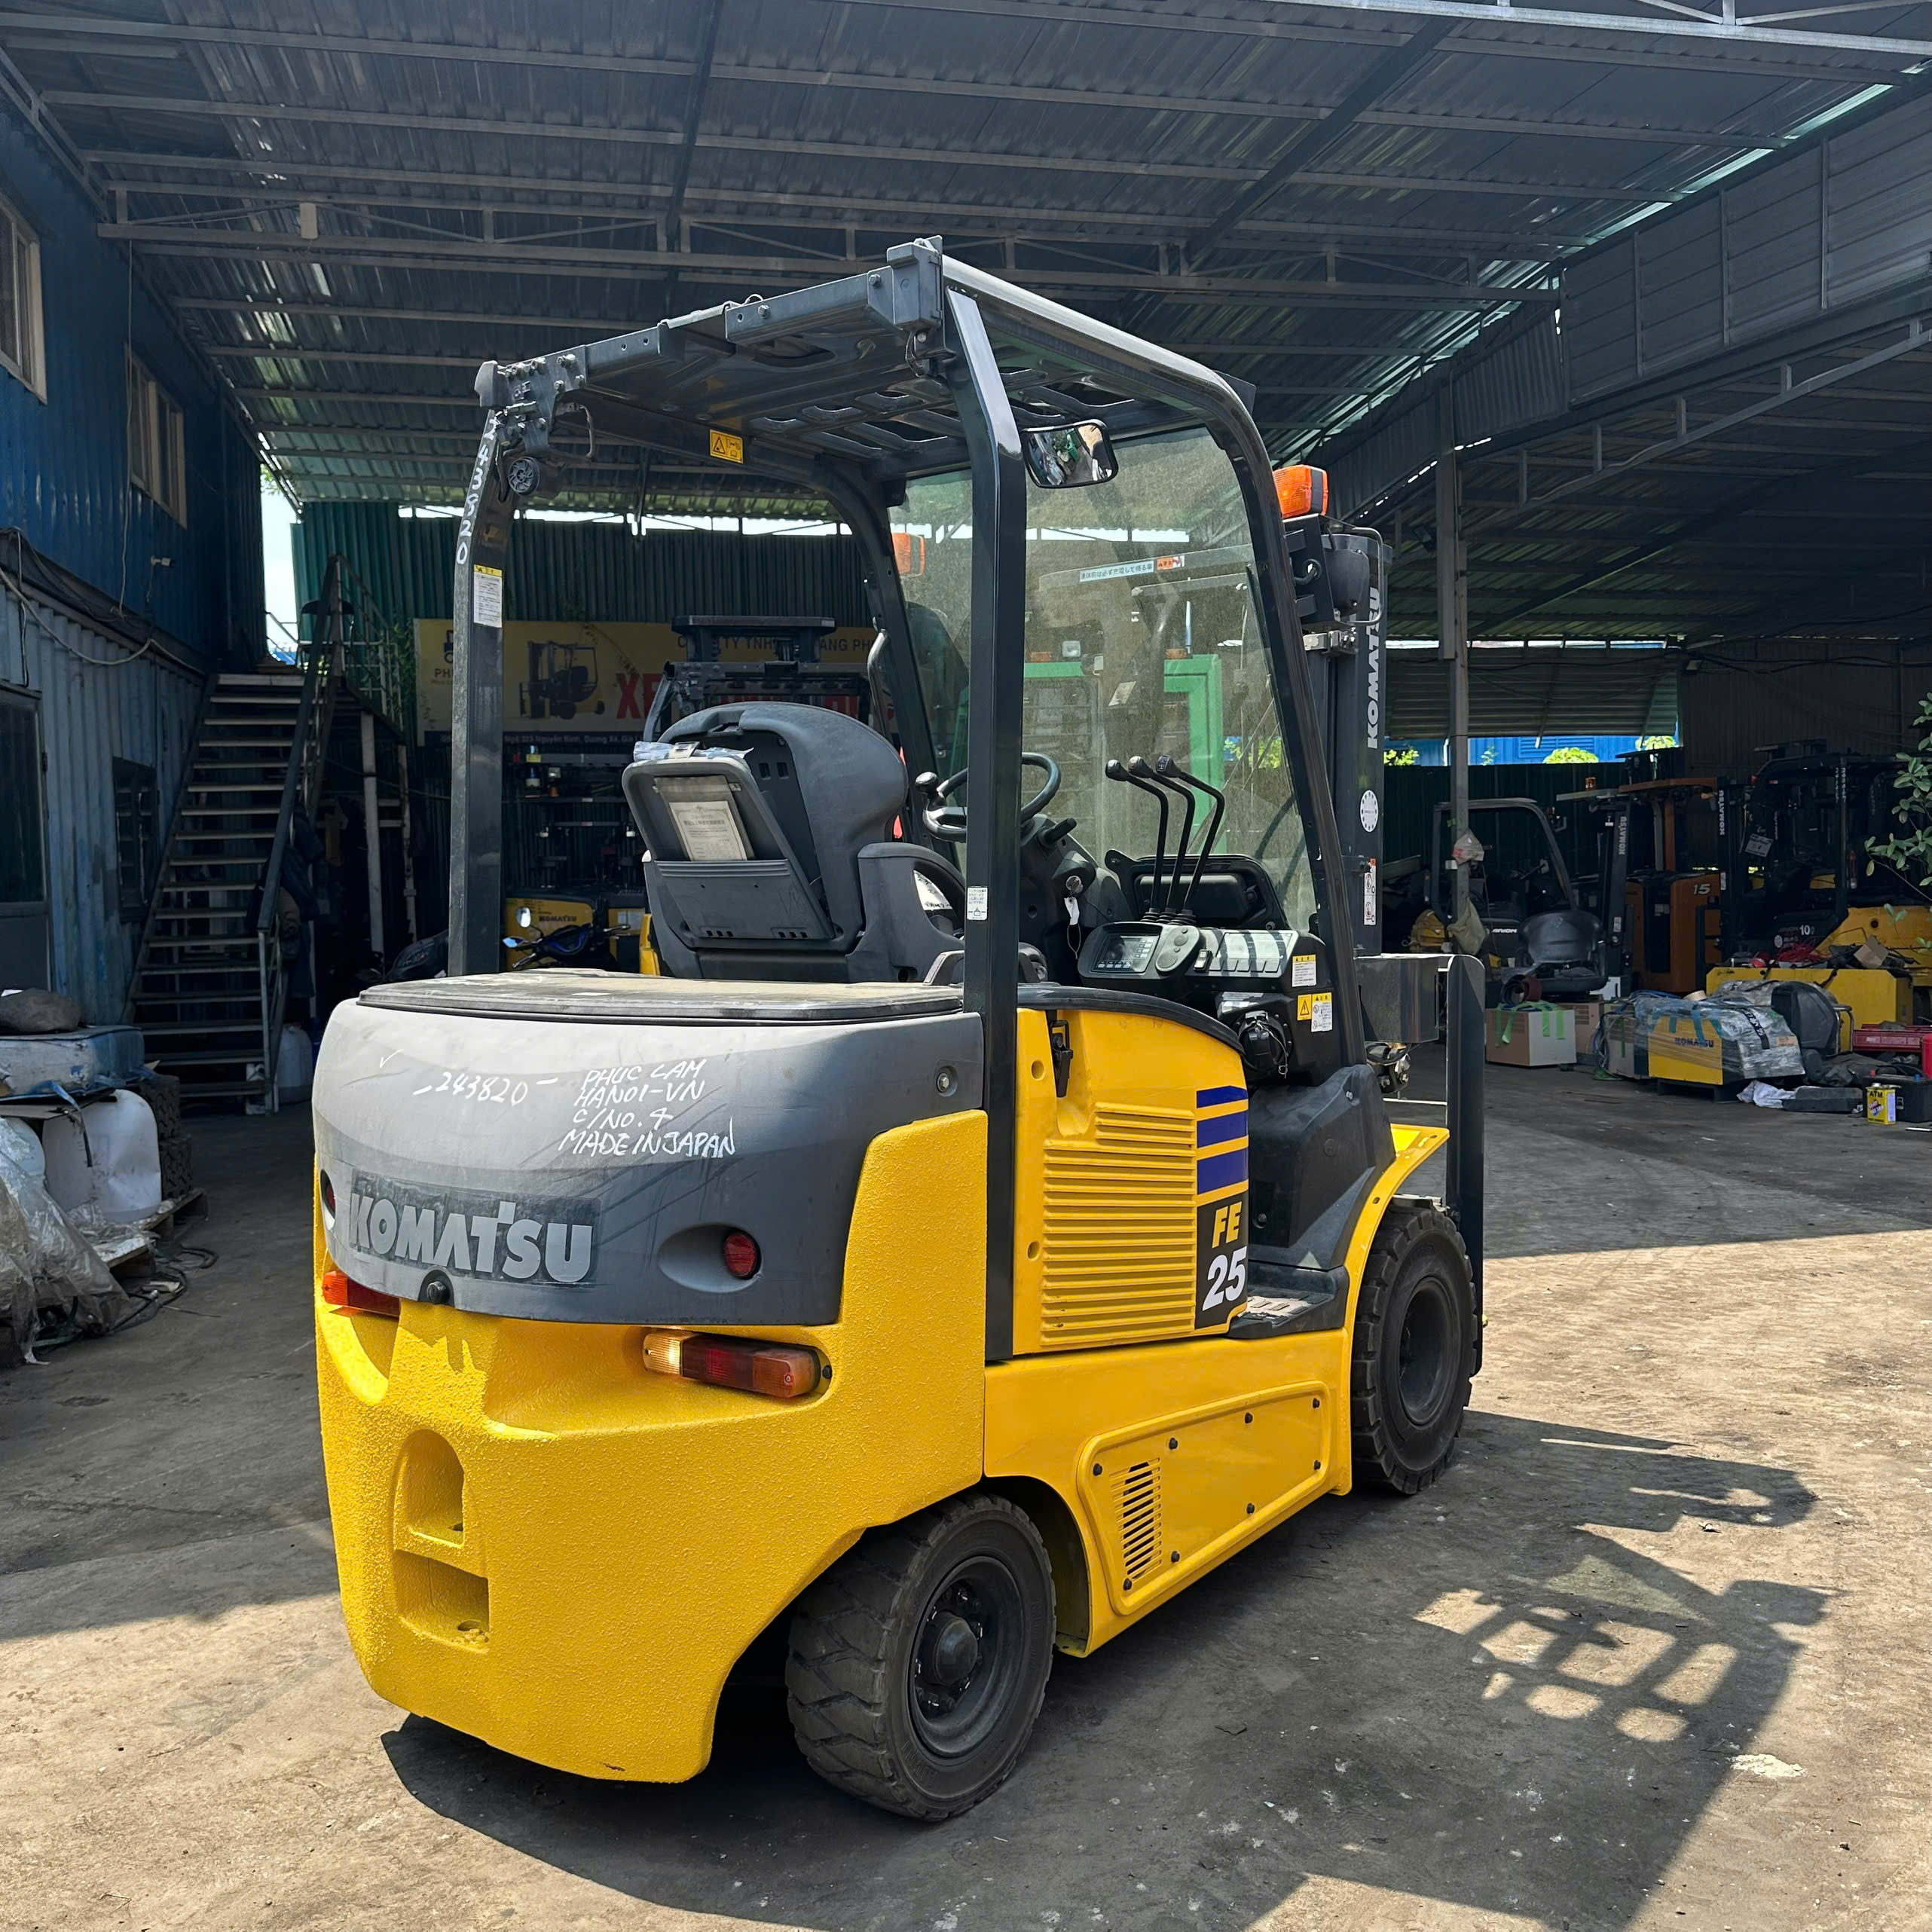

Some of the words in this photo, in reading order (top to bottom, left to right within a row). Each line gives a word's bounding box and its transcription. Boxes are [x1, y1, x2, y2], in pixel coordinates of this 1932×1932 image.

[1366, 586, 1380, 749] KOMATSU
[1618, 816, 1628, 855] KOMATSU
[1693, 883, 1711, 895] 15
[1675, 1037, 1714, 1047] KOMASU
[580, 1065, 642, 1090] PHUC
[558, 1128, 630, 1157] MADE
[662, 1117, 735, 1158] JAPAN
[350, 1191, 593, 1282] KOMATSU
[1212, 1201, 1243, 1249] FE
[1202, 1246, 1248, 1311] 25
